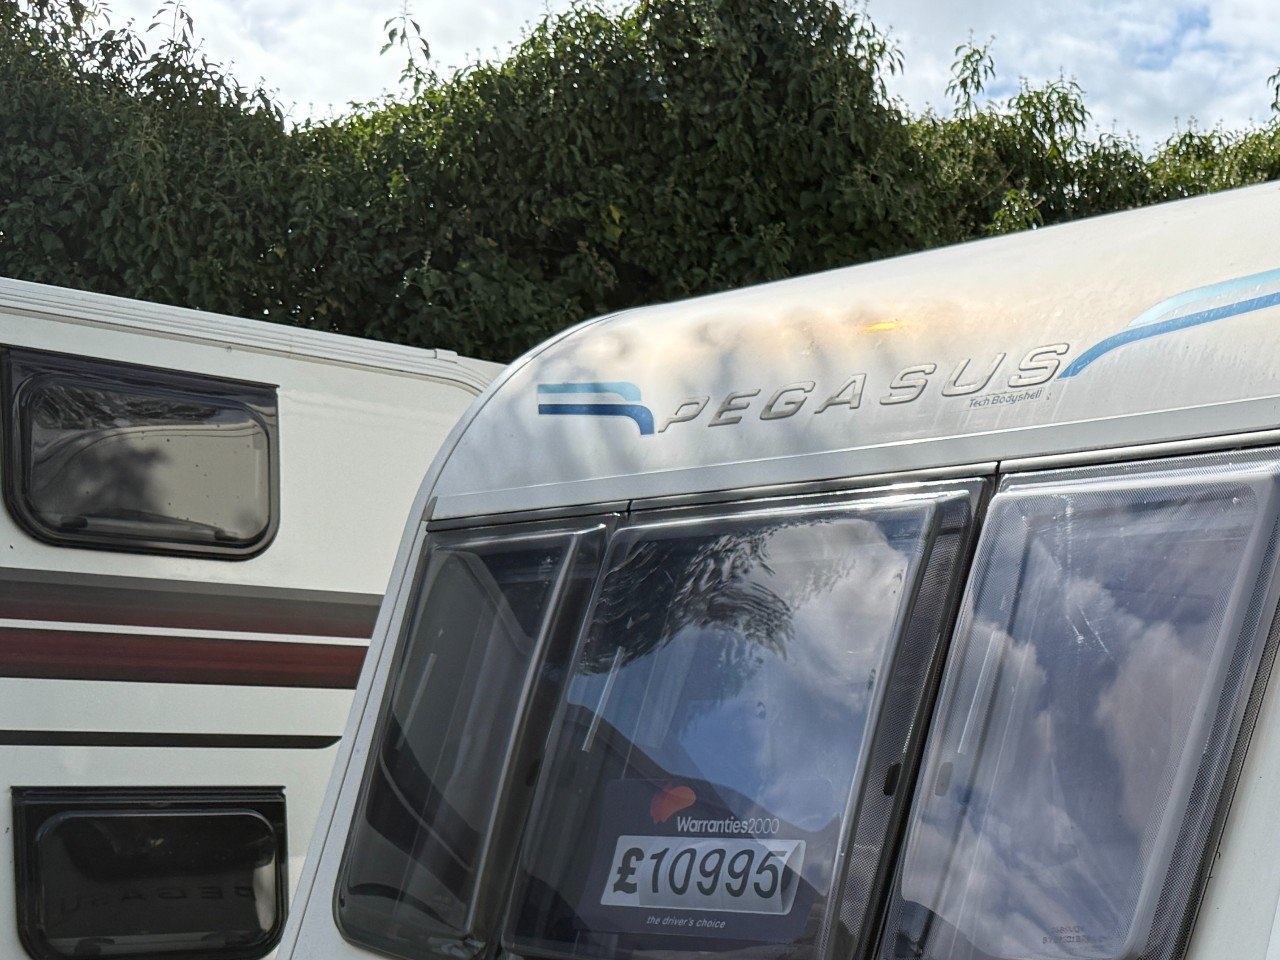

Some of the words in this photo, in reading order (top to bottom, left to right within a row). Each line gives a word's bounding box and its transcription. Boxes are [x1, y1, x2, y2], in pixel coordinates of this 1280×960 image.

[658, 343, 1070, 433] PEGASUS
[969, 397, 990, 408] Tech
[991, 389, 1042, 405] Bodyshell
[677, 816, 779, 834] Warranties2000
[612, 847, 787, 899] £10995
[647, 916, 661, 925] the
[662, 917, 694, 927] driver's
[696, 919, 726, 928] choice
